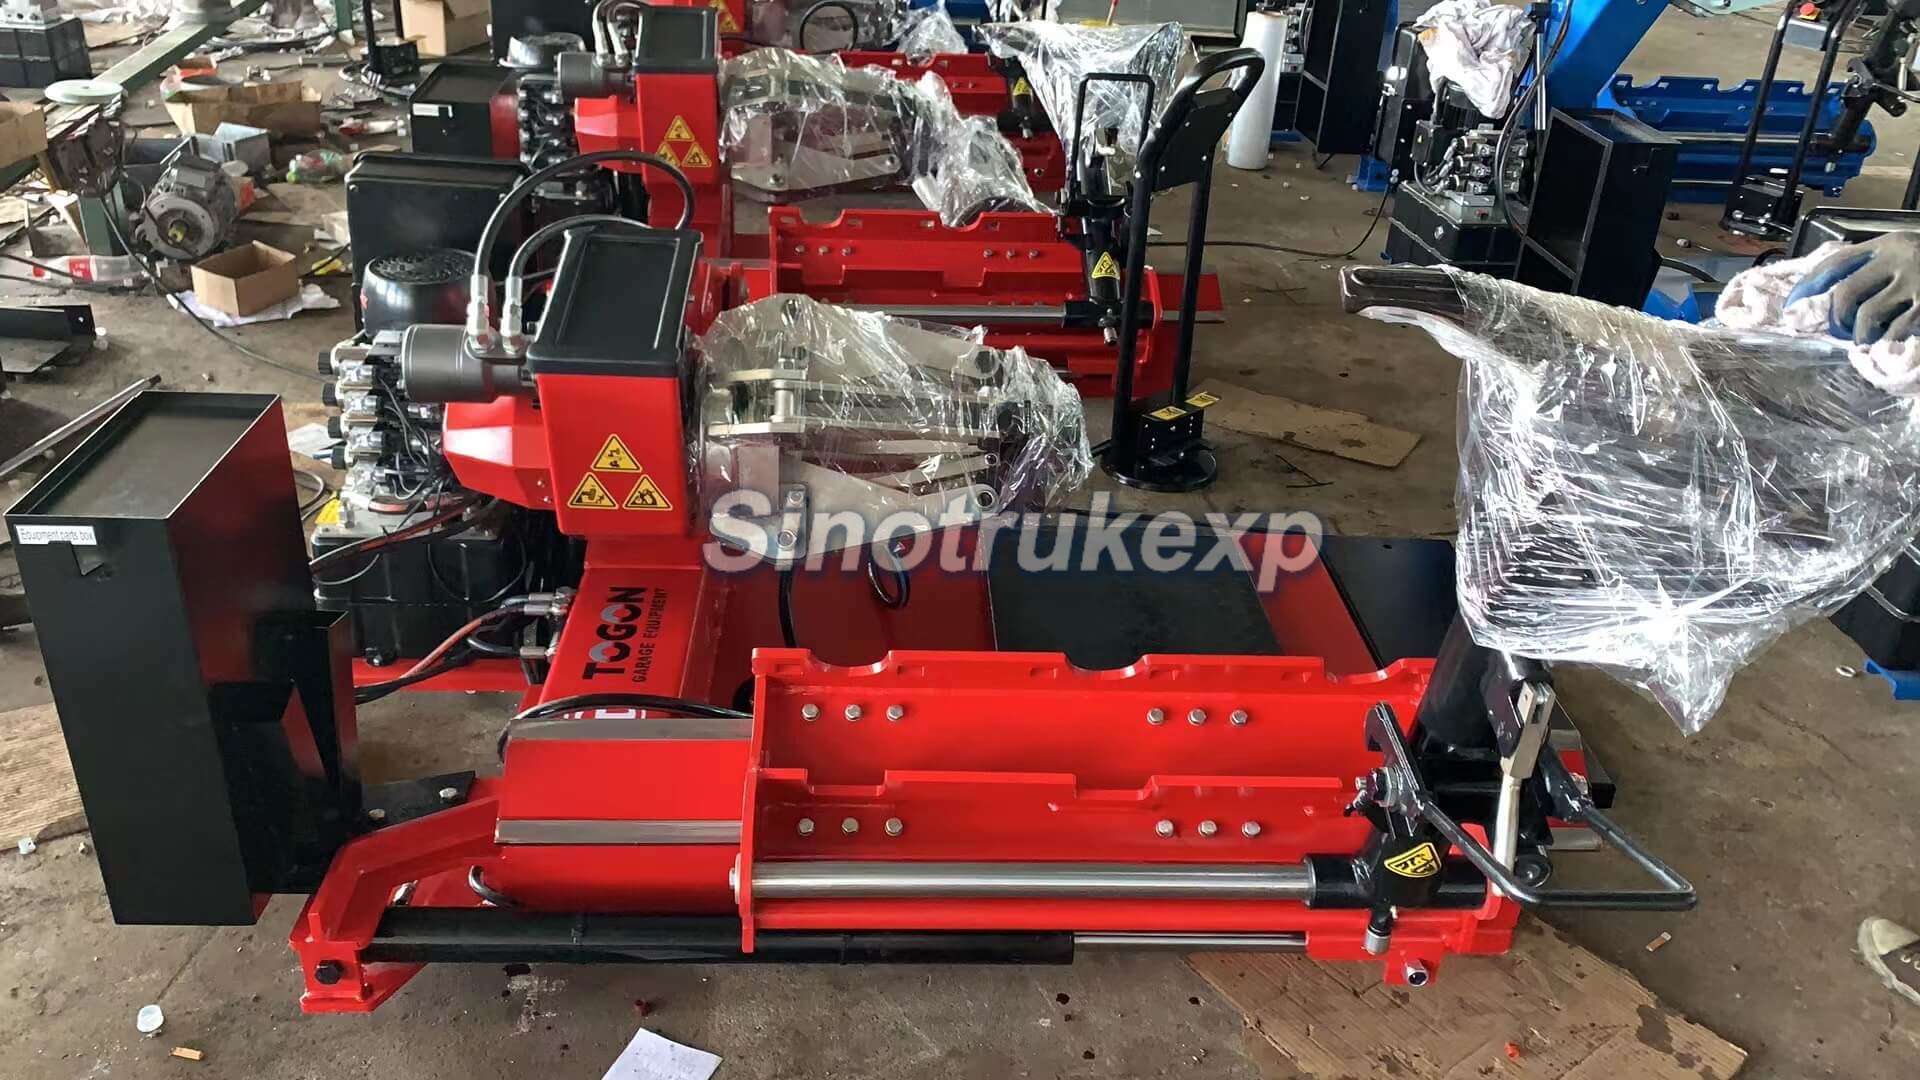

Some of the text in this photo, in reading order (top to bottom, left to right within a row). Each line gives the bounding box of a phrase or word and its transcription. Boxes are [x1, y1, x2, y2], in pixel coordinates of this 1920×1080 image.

[20, 527, 93, 542] Equipment parts box
[582, 586, 647, 680] TOGON
[632, 587, 668, 683] GARAGE EQUIPMENT
